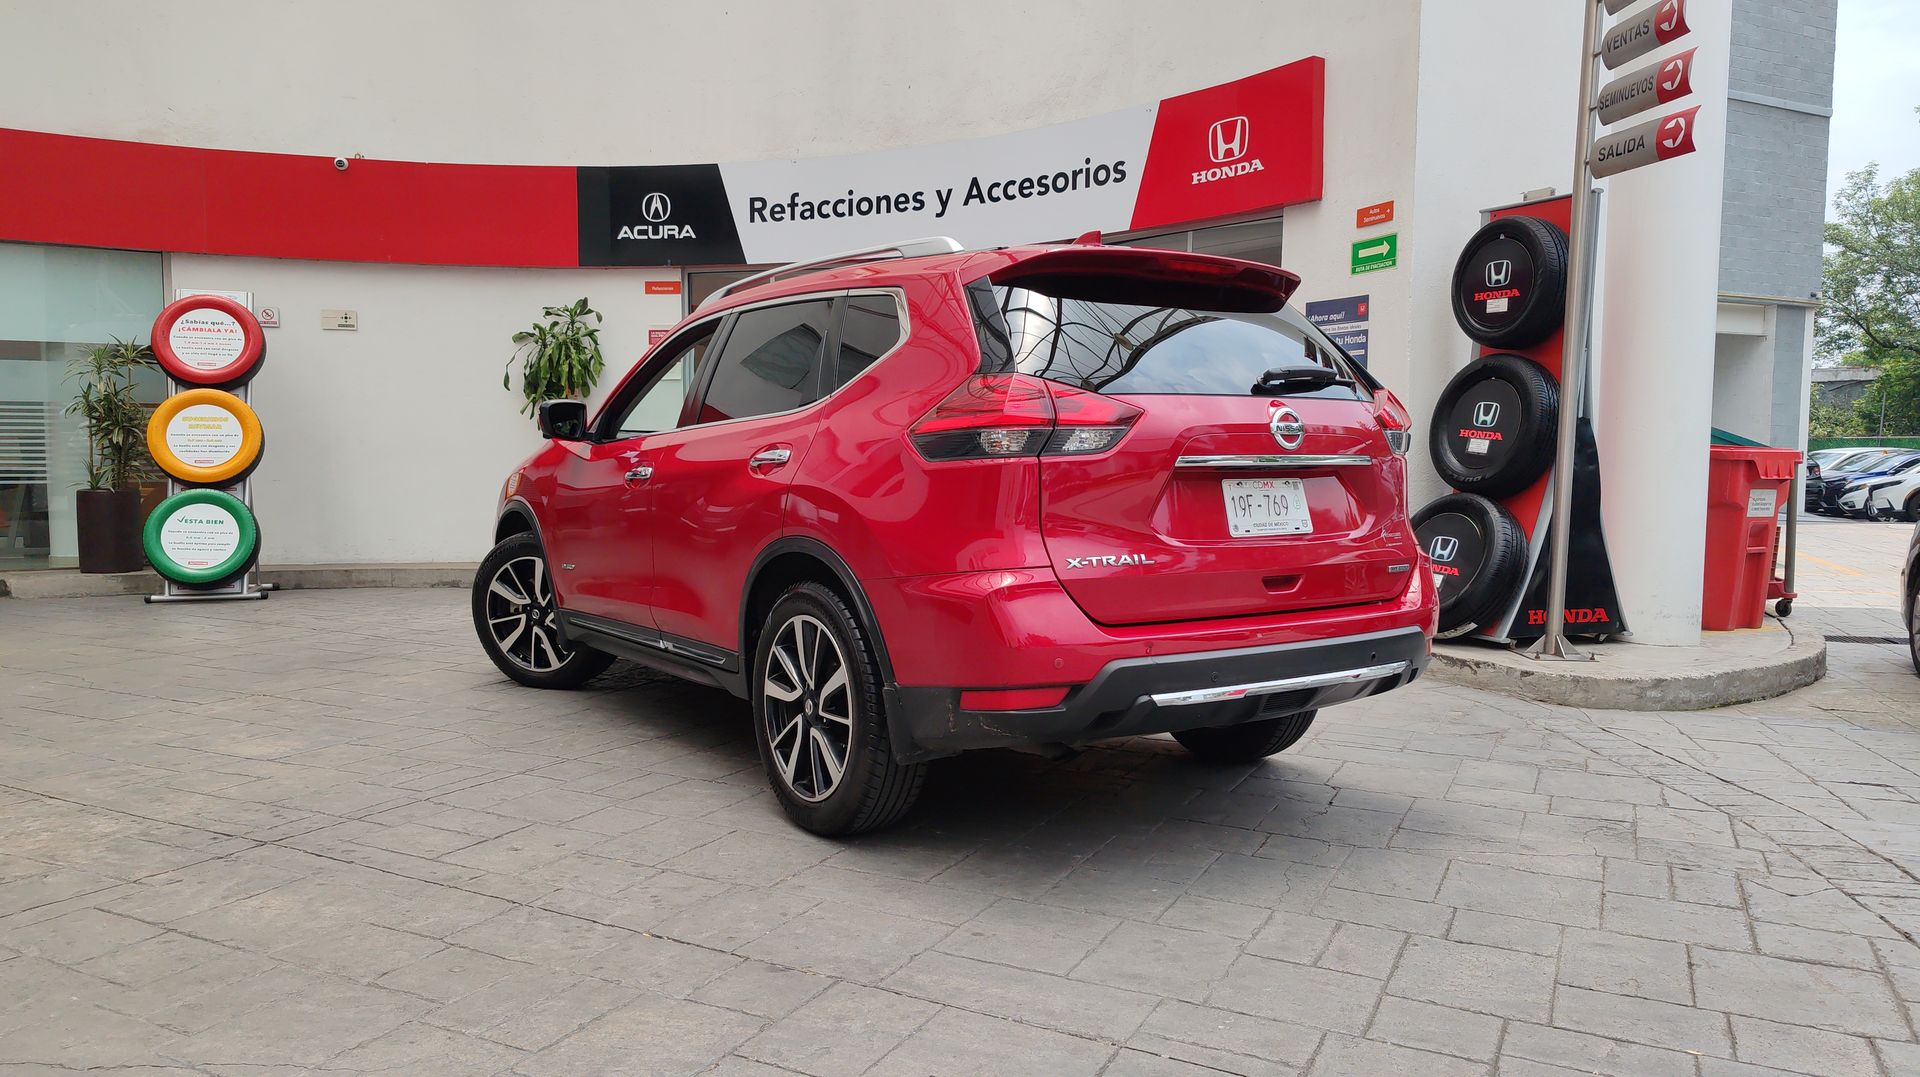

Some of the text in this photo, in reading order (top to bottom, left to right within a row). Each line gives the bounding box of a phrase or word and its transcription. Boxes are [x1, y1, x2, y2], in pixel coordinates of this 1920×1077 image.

[1606, 19, 1650, 53] VENTAS
[1599, 76, 1654, 111] SEMINUEVOS
[1598, 135, 1645, 162] SALIDA
[1191, 158, 1264, 185] HONDA
[749, 157, 1127, 223] Refacciones y Accesorios
[617, 224, 696, 240] ACURA
[1474, 288, 1520, 301] HONDA
[1344, 333, 1367, 345] Honda
[1276, 424, 1304, 432] NISSAN
[1458, 428, 1503, 441] HONDA
[1252, 480, 1275, 490] CDMX
[1231, 494, 1289, 518] 19F-769
[1066, 553, 1155, 569] X-TRAIL
[1431, 563, 1459, 576] NDA
[1528, 607, 1610, 625] HNDA
